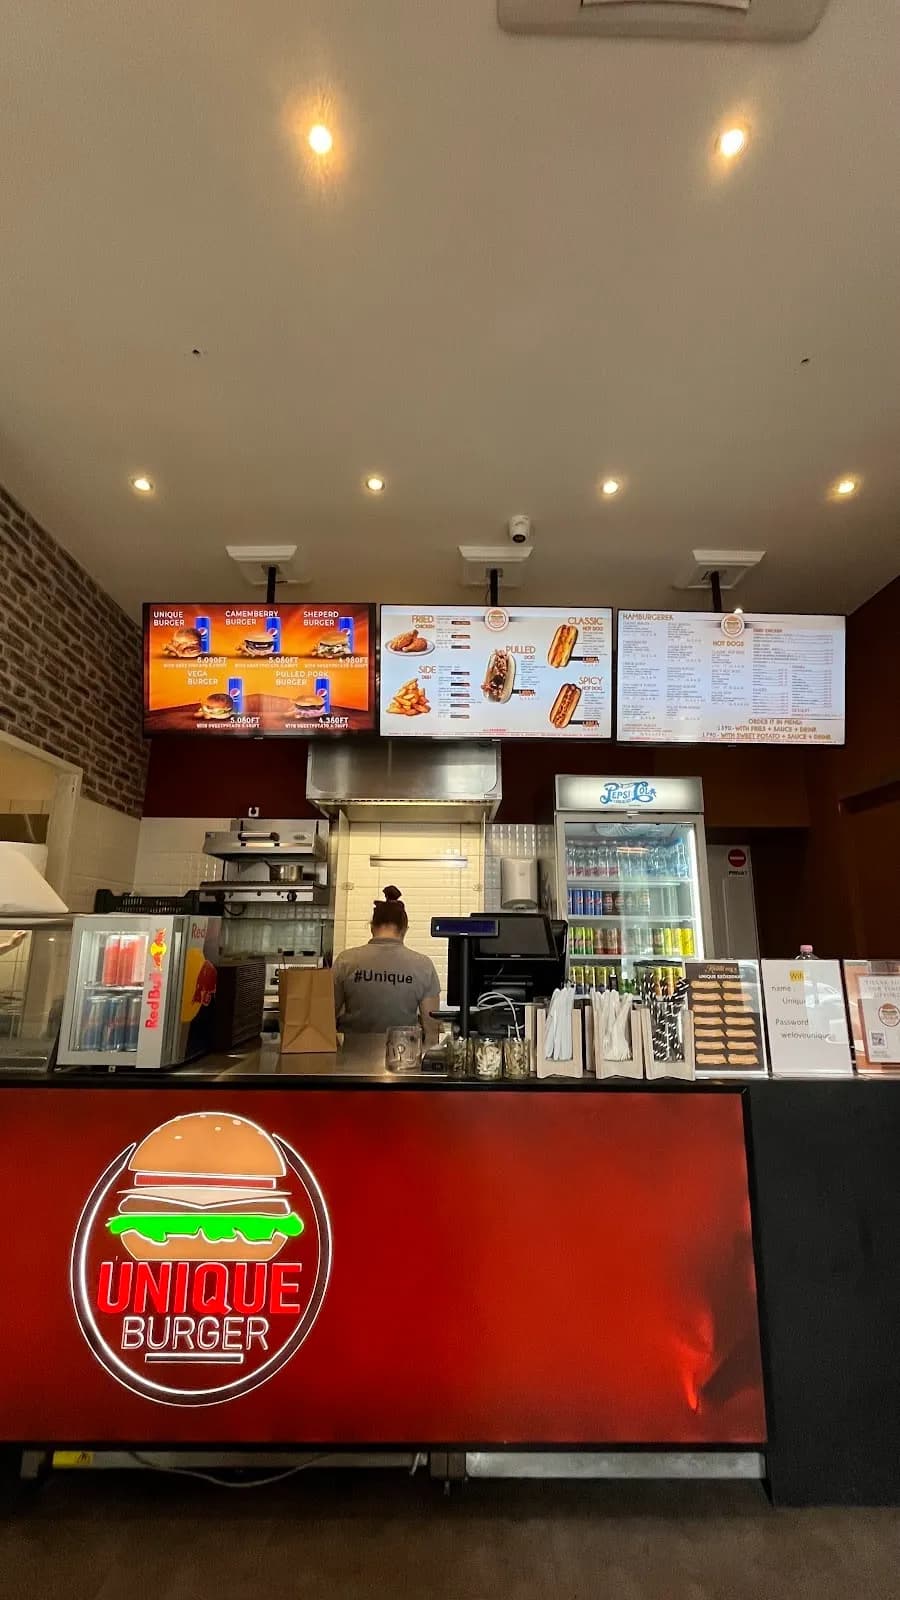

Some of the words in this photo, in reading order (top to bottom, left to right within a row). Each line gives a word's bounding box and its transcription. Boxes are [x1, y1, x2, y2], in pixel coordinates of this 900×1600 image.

[153, 611, 184, 619] UNIQUE
[225, 610, 279, 618] CAMEMBERRY
[153, 619, 185, 627] BURGER
[225, 618, 257, 626] BURGER
[303, 619, 335, 627] BURGER
[411, 615, 434, 624] FRIED
[567, 616, 603, 626] CLASSIC
[505, 645, 536, 654] PULLED
[418, 666, 437, 674] SIDE
[275, 678, 307, 686] BURGER
[579, 677, 603, 685] SPICY
[354, 968, 413, 986] #Unique
[145, 1001, 161, 1030] Red
[775, 1018, 809, 1026] Password
[97, 1262, 302, 1315] UNIQUE
[121, 1316, 269, 1350] BURGER
